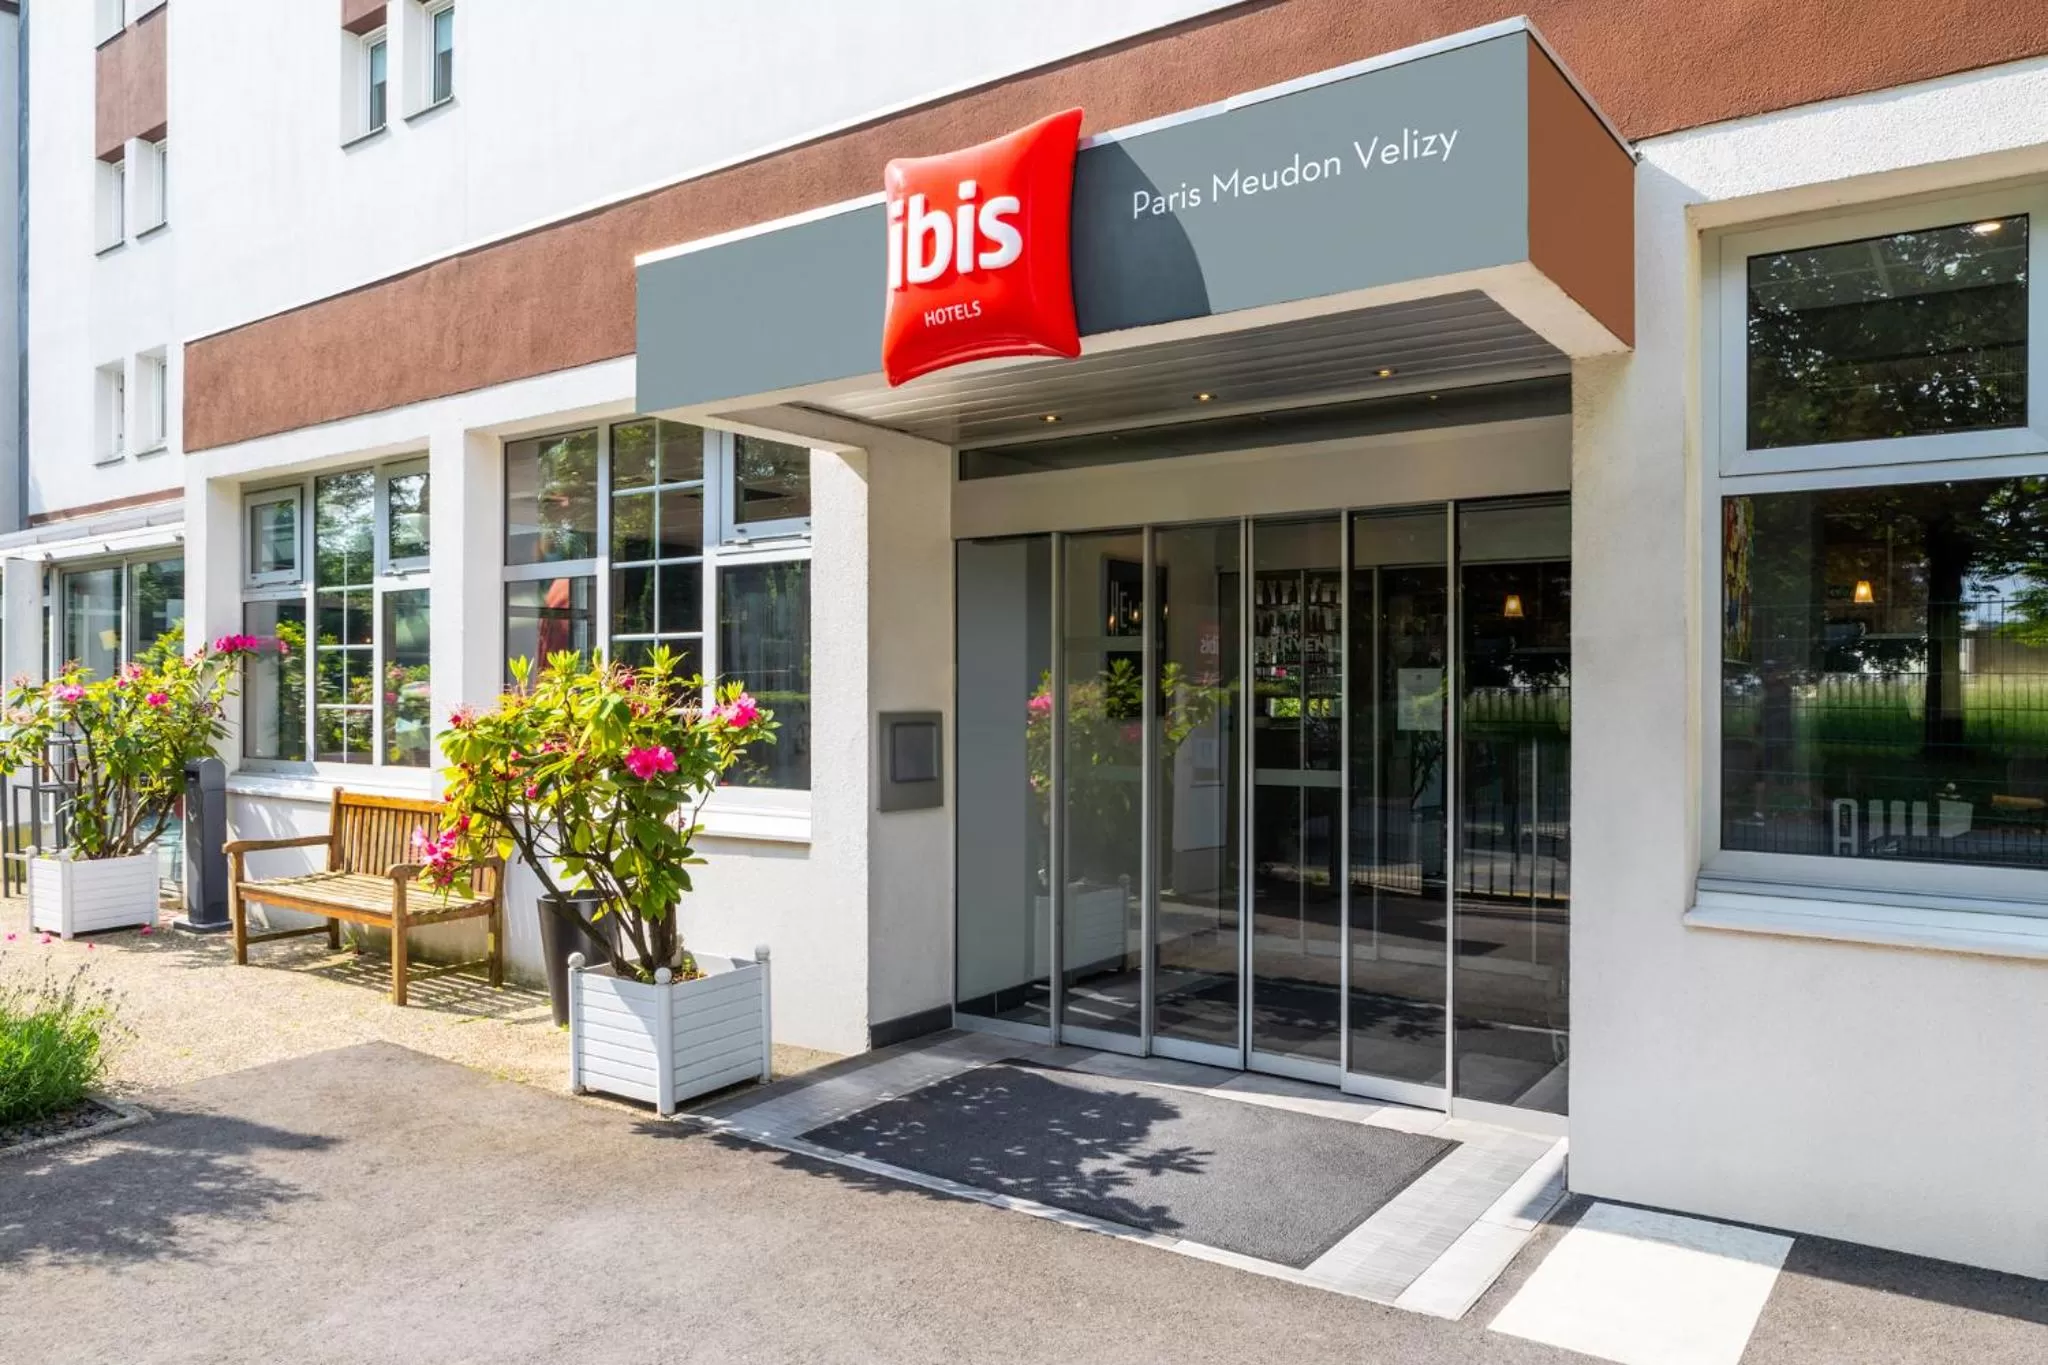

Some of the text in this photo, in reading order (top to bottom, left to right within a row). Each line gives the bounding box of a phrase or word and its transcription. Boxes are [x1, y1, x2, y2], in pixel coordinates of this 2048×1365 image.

[1133, 128, 1458, 219] Paris Meudon Velizy
[889, 180, 1024, 290] ibis
[924, 300, 982, 328] HOTELS
